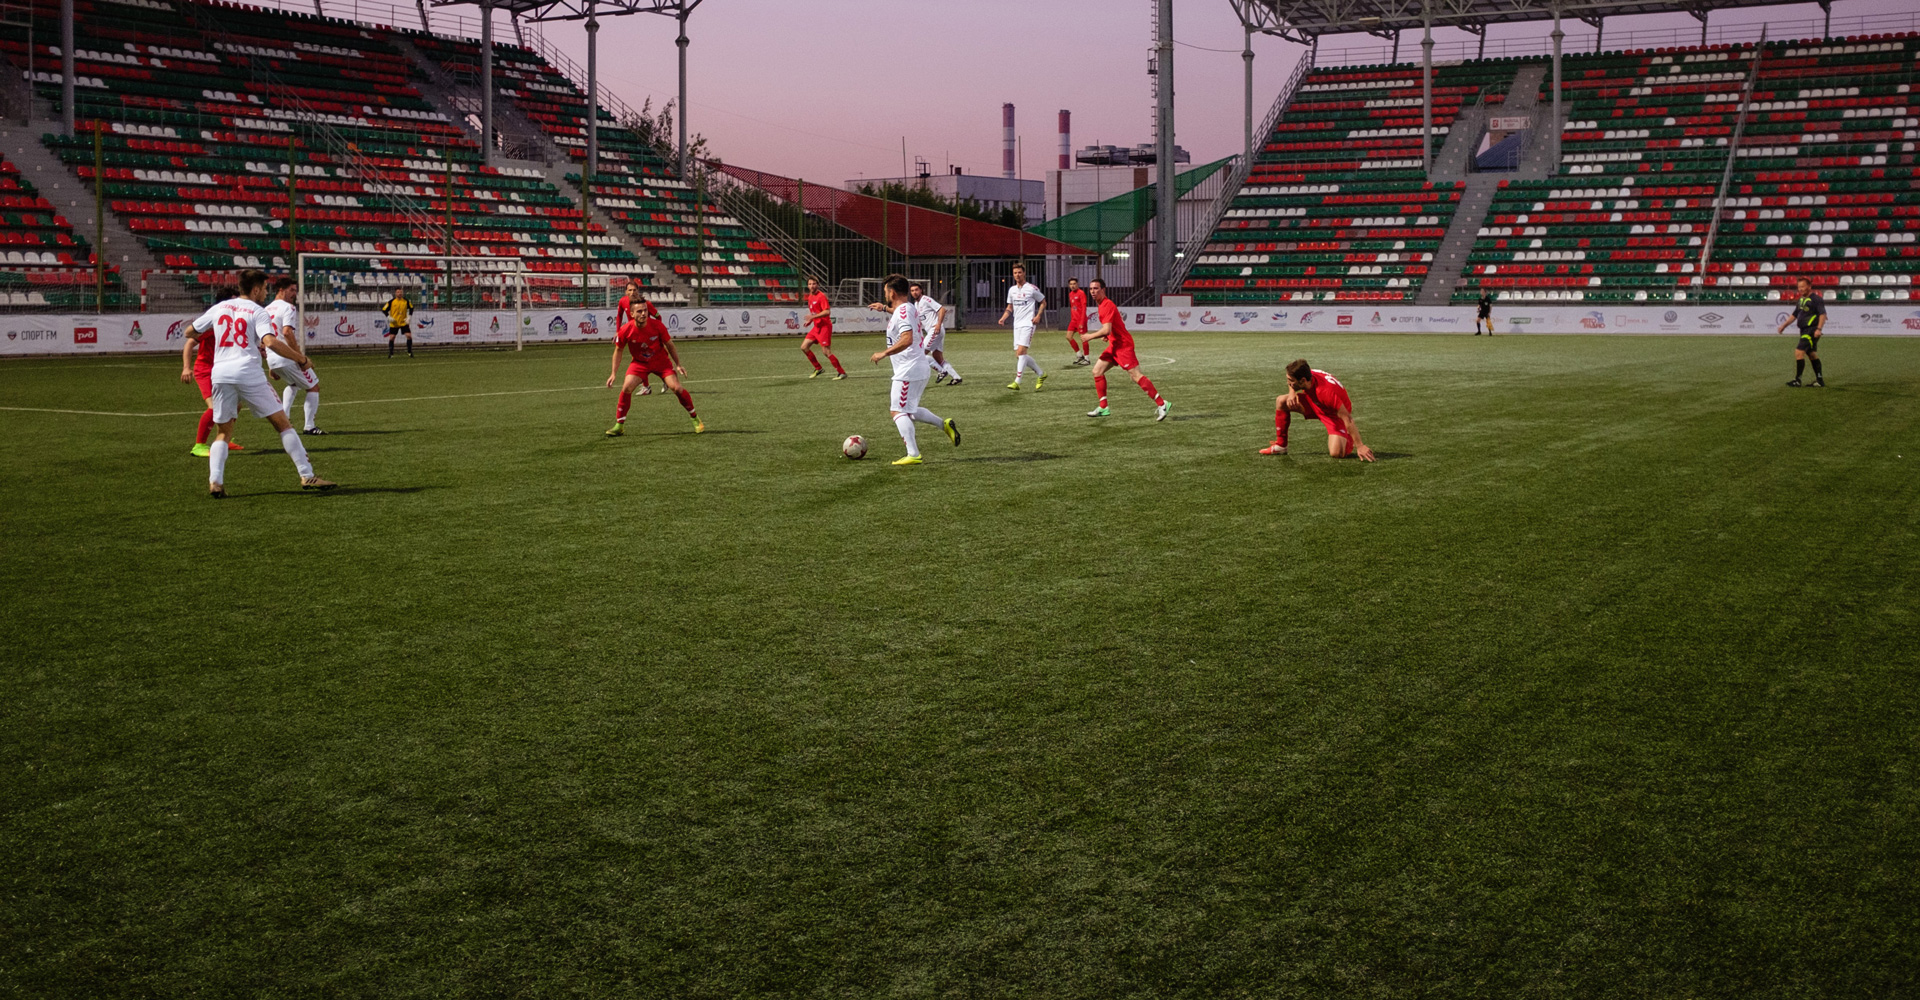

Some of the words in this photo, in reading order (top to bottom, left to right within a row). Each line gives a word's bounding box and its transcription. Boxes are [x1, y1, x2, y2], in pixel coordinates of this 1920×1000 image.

[21, 330, 45, 340] СПОРТ
[46, 330, 57, 340] FM
[218, 314, 248, 349] 28
